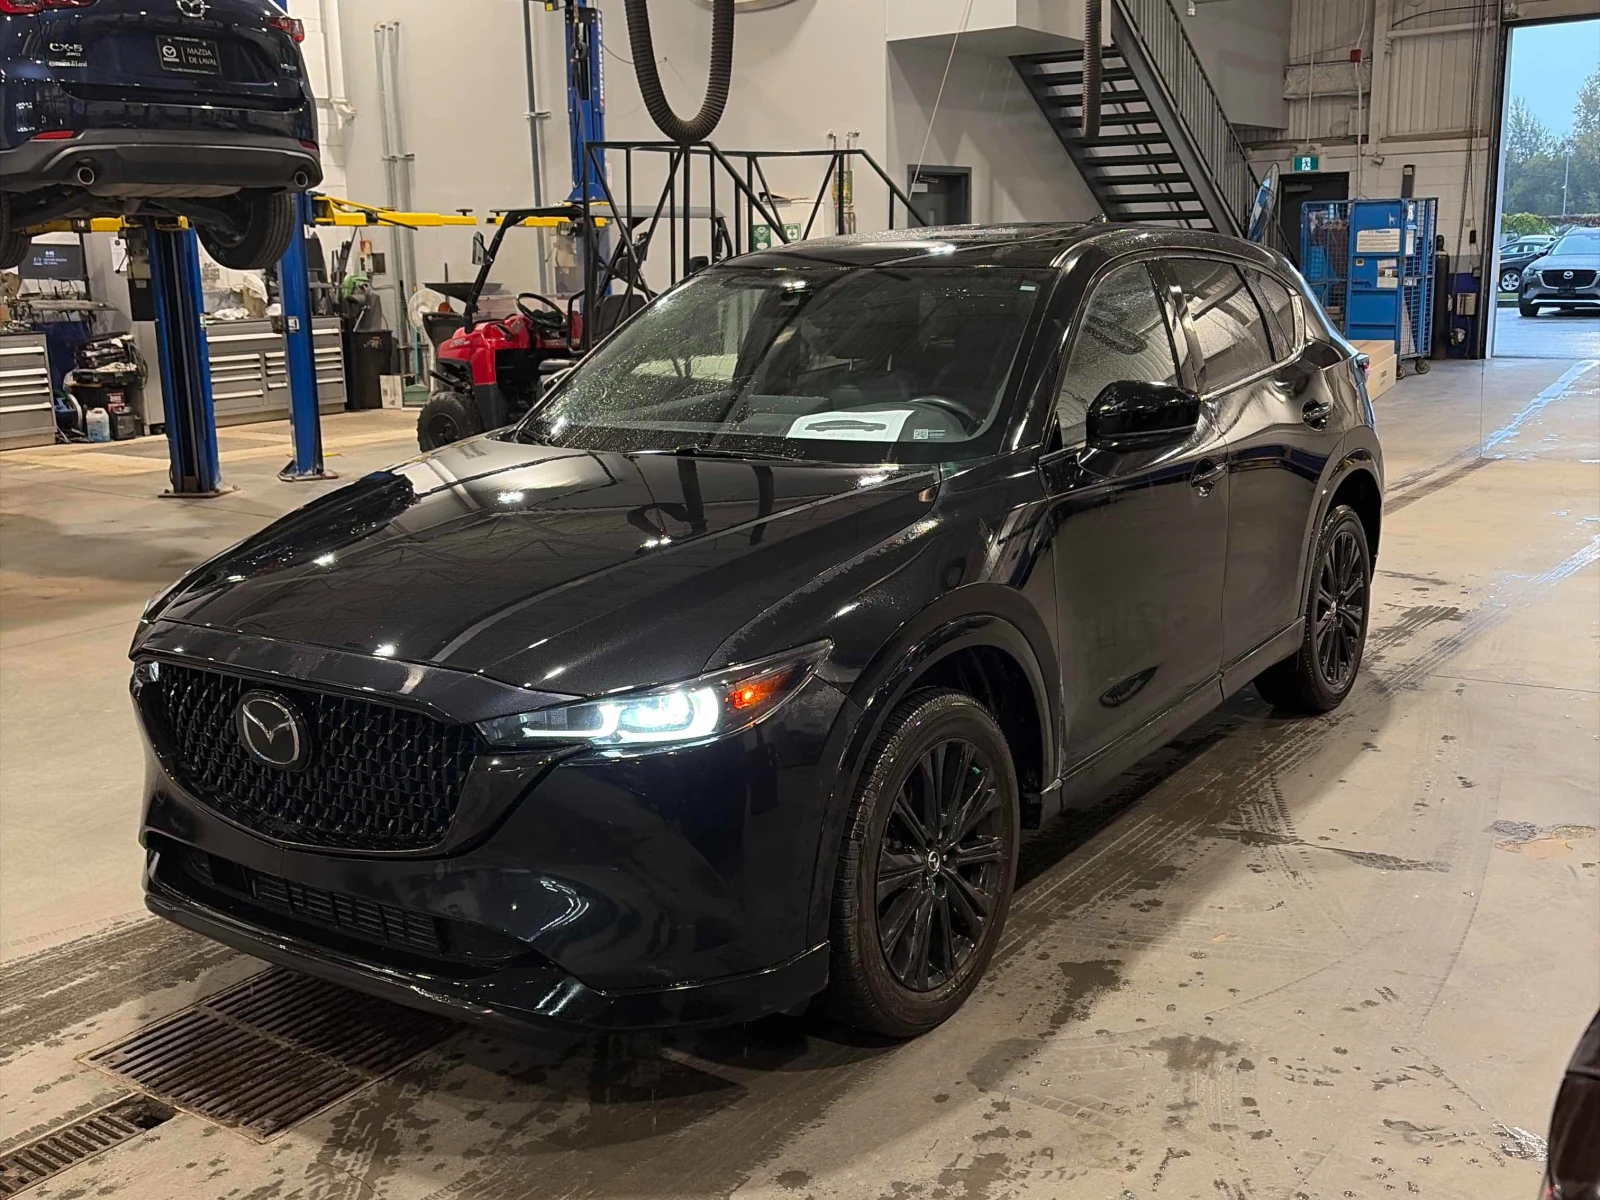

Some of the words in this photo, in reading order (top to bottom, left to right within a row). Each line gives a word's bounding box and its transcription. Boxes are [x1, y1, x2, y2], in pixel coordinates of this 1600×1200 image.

[49, 42, 83, 52] CX-5
[187, 47, 212, 56] MAZDA
[188, 56, 199, 64] DE
